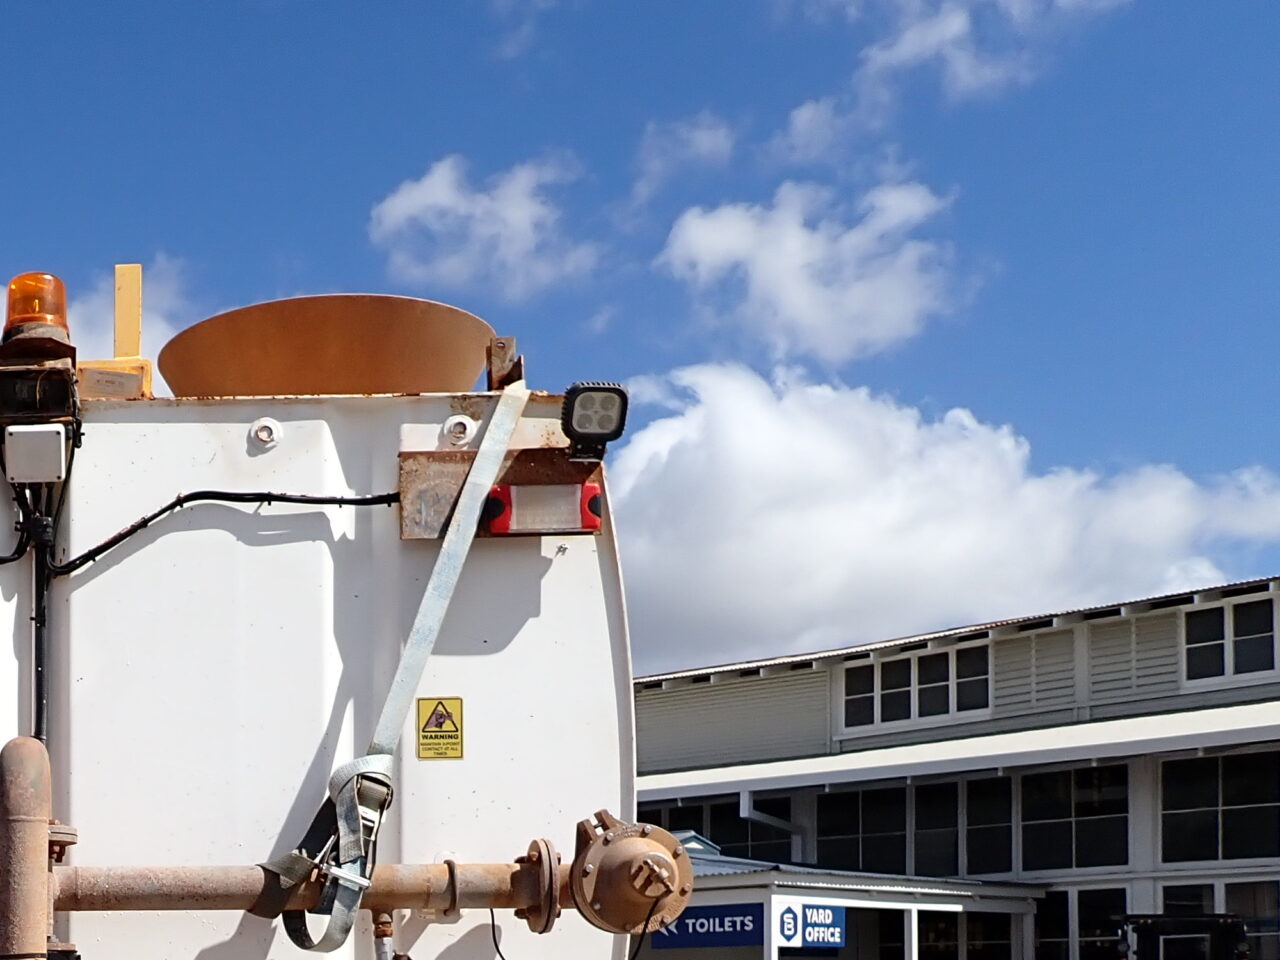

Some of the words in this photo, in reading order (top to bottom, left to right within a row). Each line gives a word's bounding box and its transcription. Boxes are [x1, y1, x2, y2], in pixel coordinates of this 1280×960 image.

[805, 908, 833, 924] YARD
[685, 916, 754, 934] TOILETS
[805, 926, 841, 942] OFFICE
